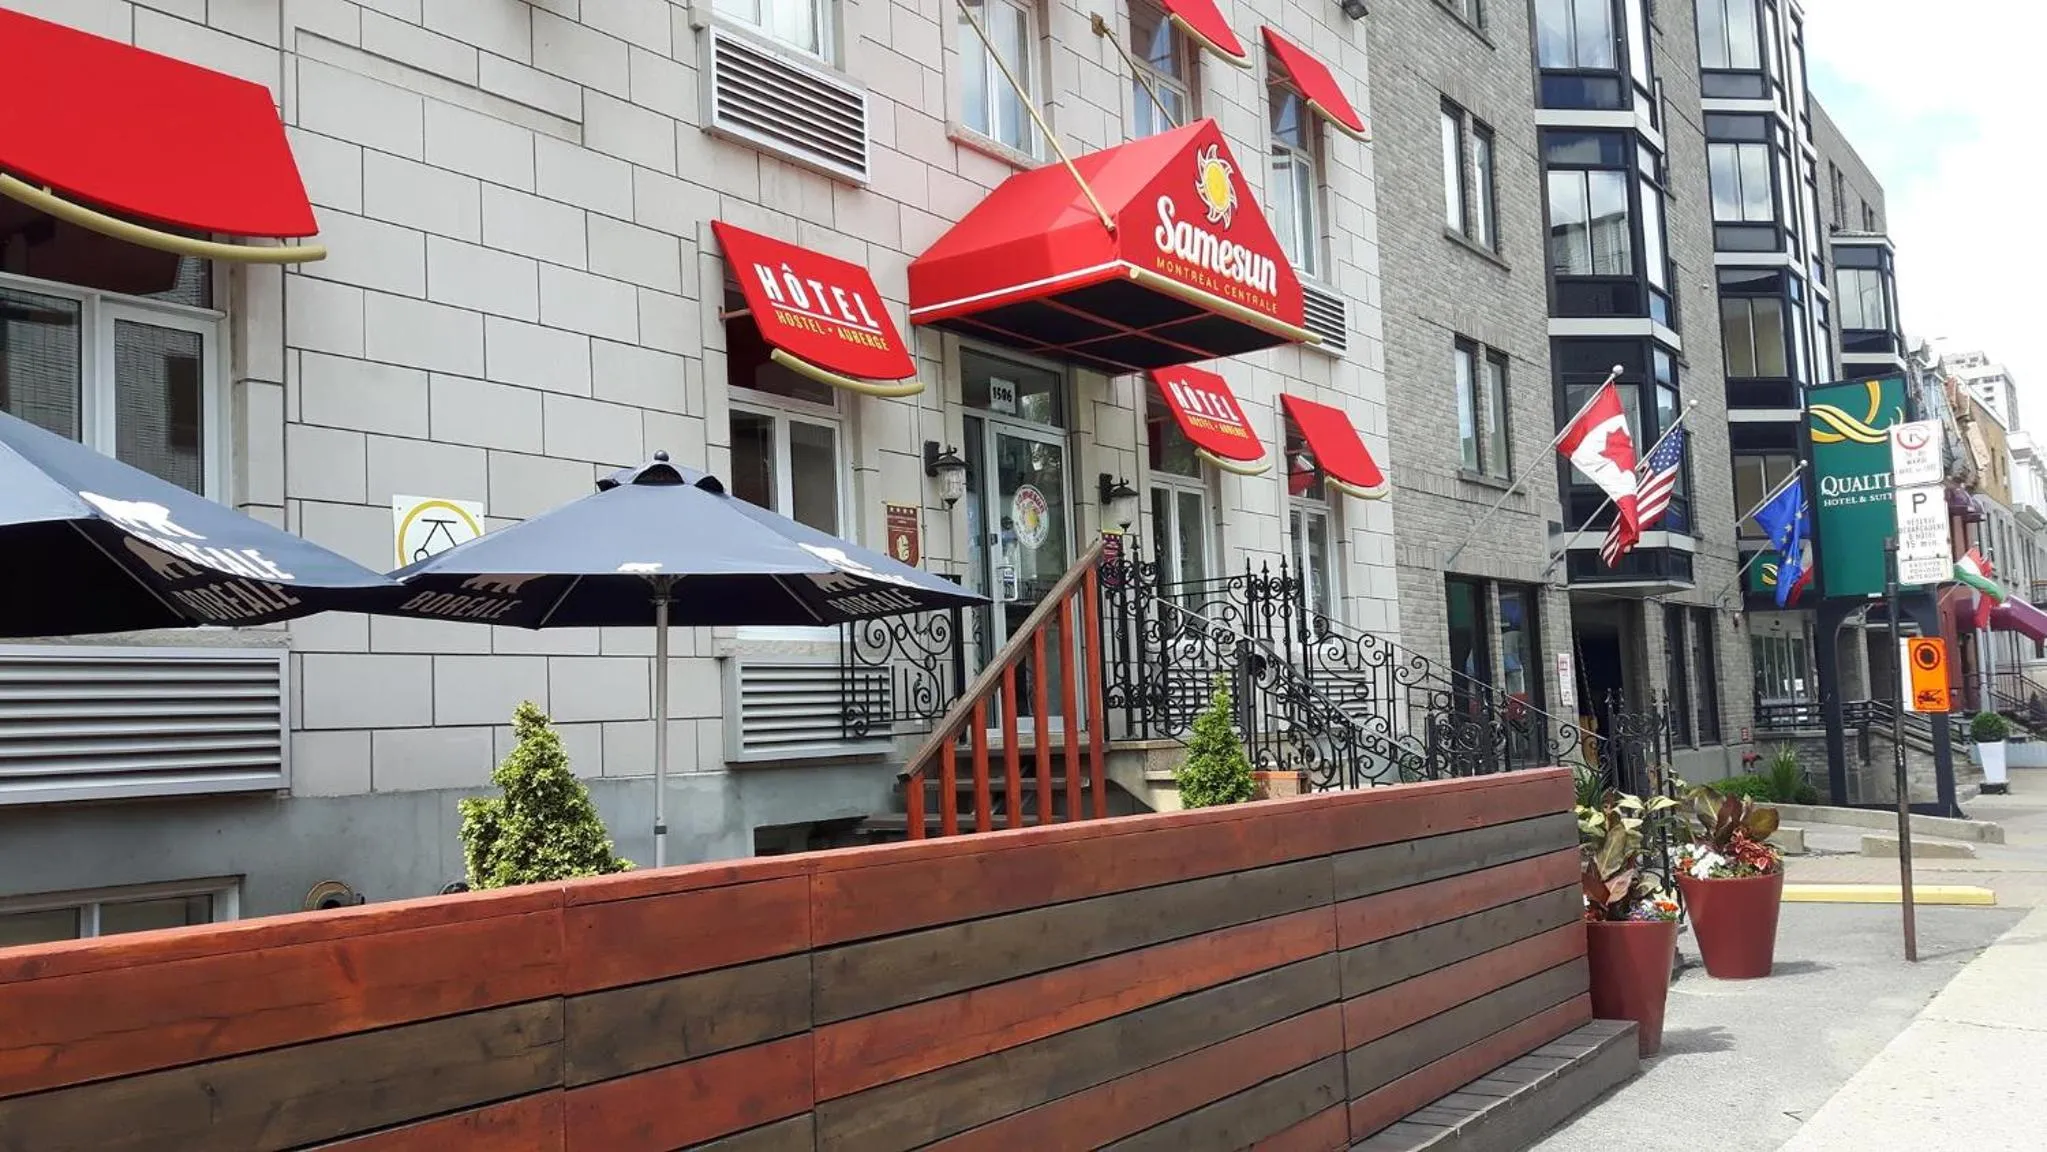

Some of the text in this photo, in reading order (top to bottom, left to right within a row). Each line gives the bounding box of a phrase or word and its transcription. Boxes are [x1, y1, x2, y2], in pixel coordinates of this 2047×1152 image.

[1155, 194, 1277, 297] Samesun
[753, 262, 880, 328] HÔTEL
[1156, 256, 1279, 314] MONTRÉAL CENTRALE
[775, 309, 890, 351] HOSTEL AUBERGE
[1168, 378, 1240, 421] HÔTEL
[1821, 472, 1893, 497] QUALIT
[1824, 496, 1858, 507] HOTEL
[1912, 492, 1927, 514] P
